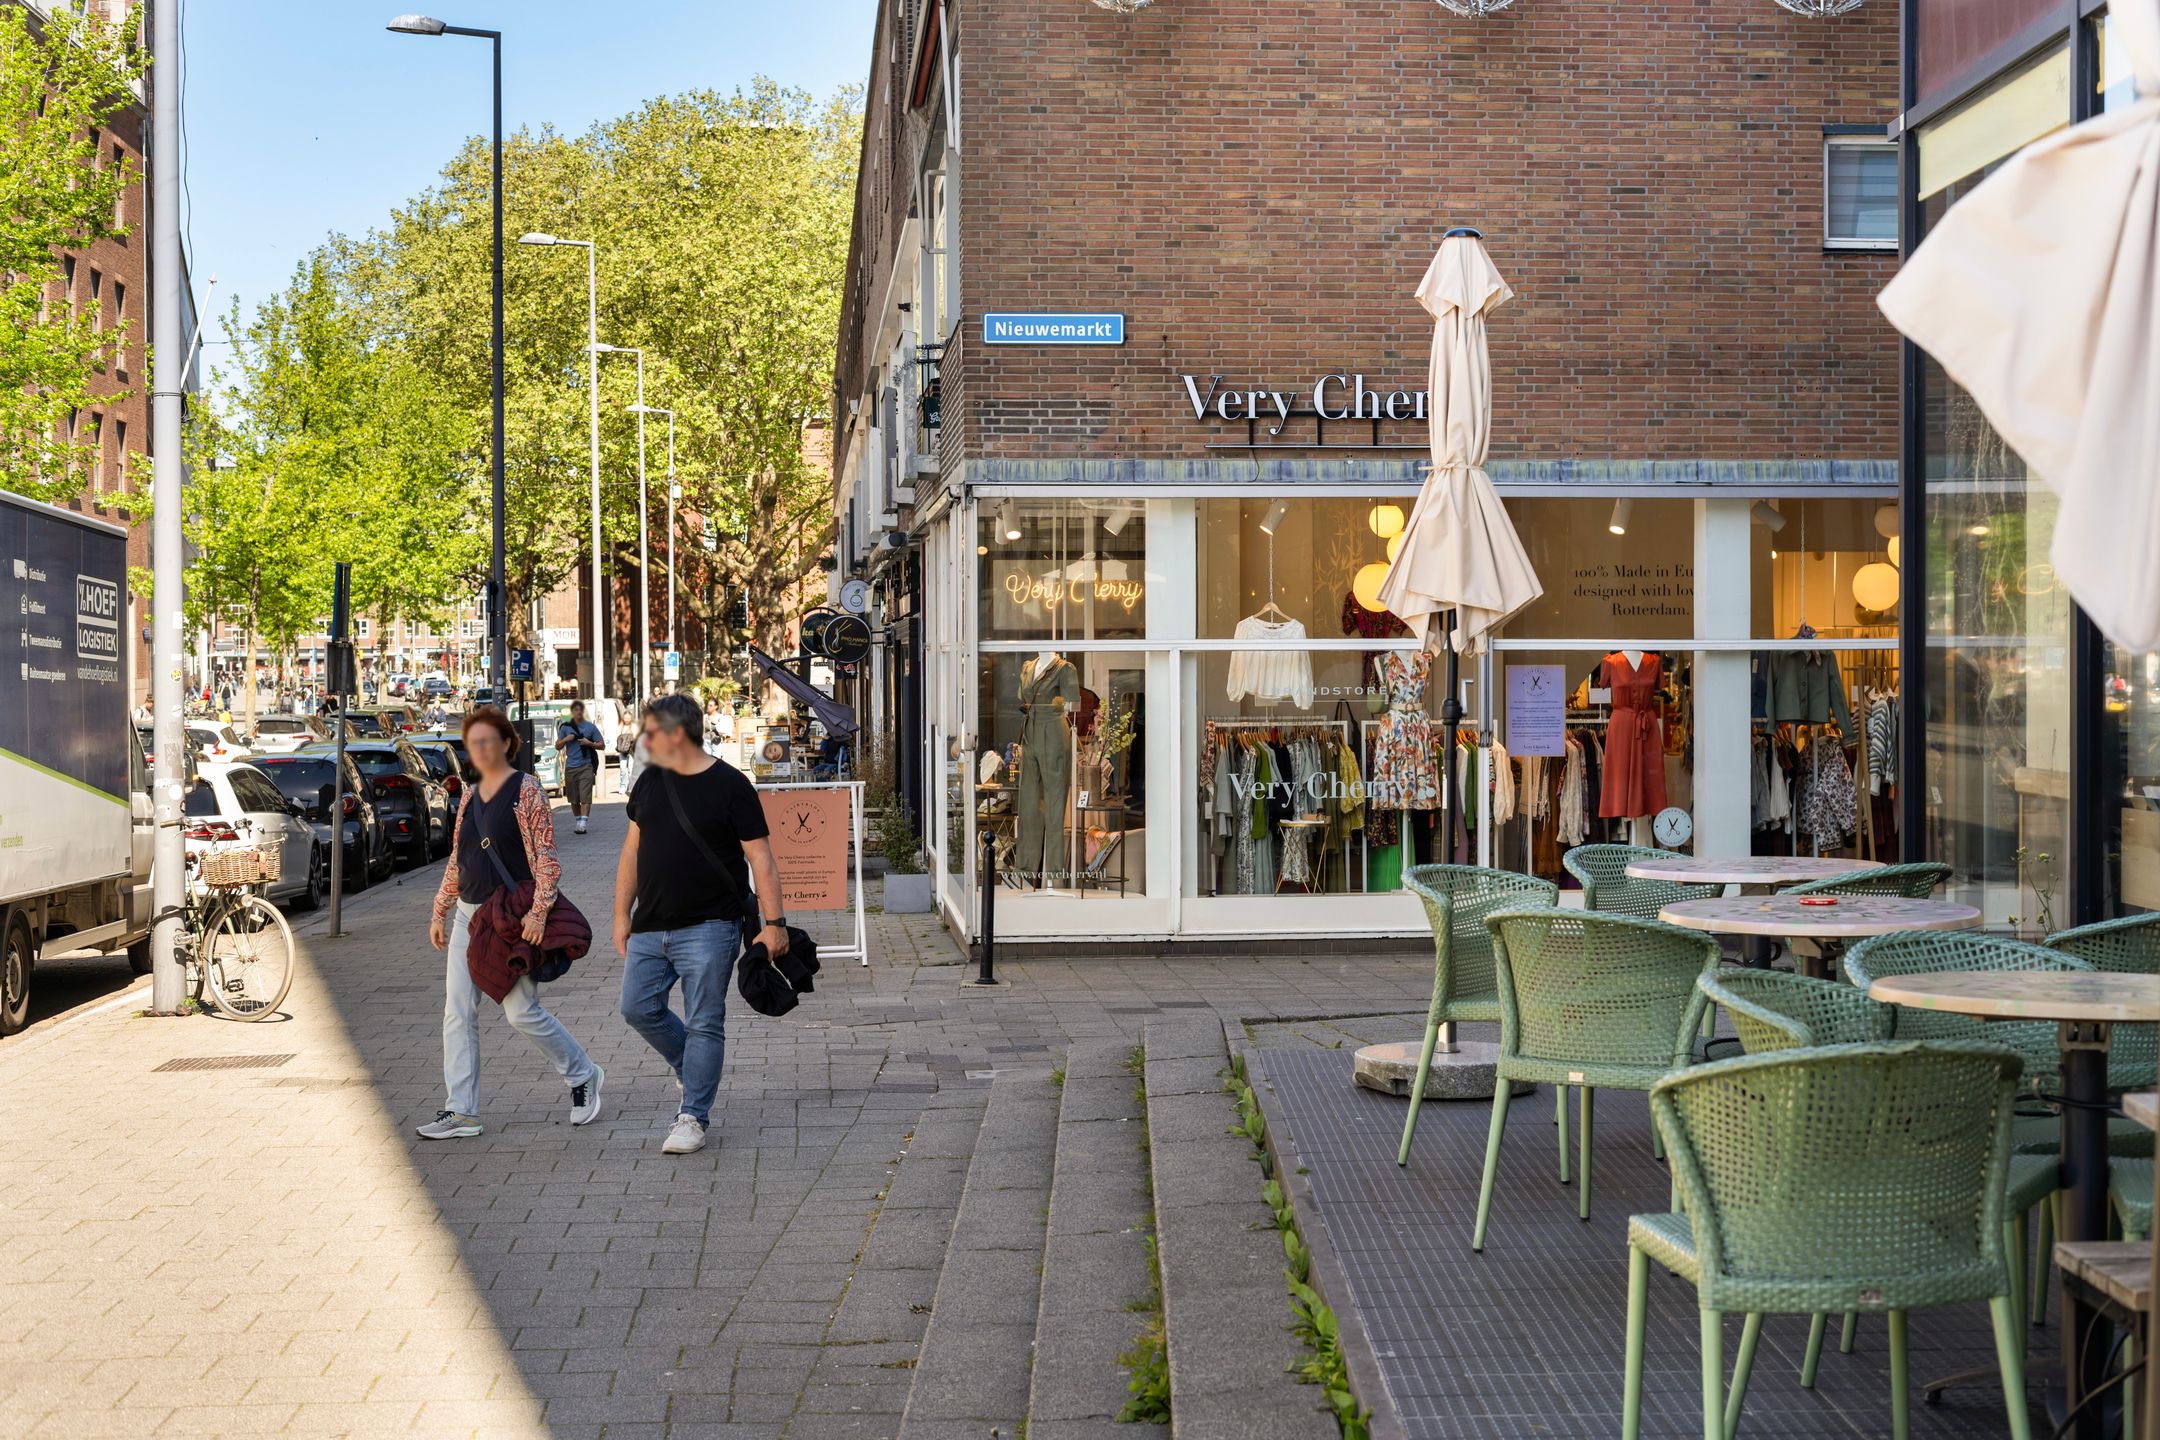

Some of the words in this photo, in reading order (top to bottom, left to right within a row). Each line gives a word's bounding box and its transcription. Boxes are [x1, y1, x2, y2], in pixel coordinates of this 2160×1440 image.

[995, 321, 1112, 337] Nieuwemarkt
[1180, 373, 1297, 435] Very
[1313, 373, 1430, 421] Cher
[1575, 564, 1609, 578] 100%
[1614, 564, 1651, 578] Made
[1656, 564, 1669, 578] in
[1675, 564, 1694, 578] Eu
[1005, 573, 1063, 610] Very
[1070, 572, 1143, 610] Cherry
[1574, 583, 1636, 601] designed
[1641, 583, 1671, 597] with
[1676, 583, 1694, 597] lov
[86, 584, 116, 617] HOEF
[1612, 602, 1691, 616] Rotterdam.
[79, 628, 117, 652] LOGISTIEK
[553, 630, 577, 640] MOR
[511, 650, 521, 666] P
[1227, 772, 1298, 807] Very
[1307, 771, 1411, 805] Cherry
[794, 891, 820, 901] Cherry
